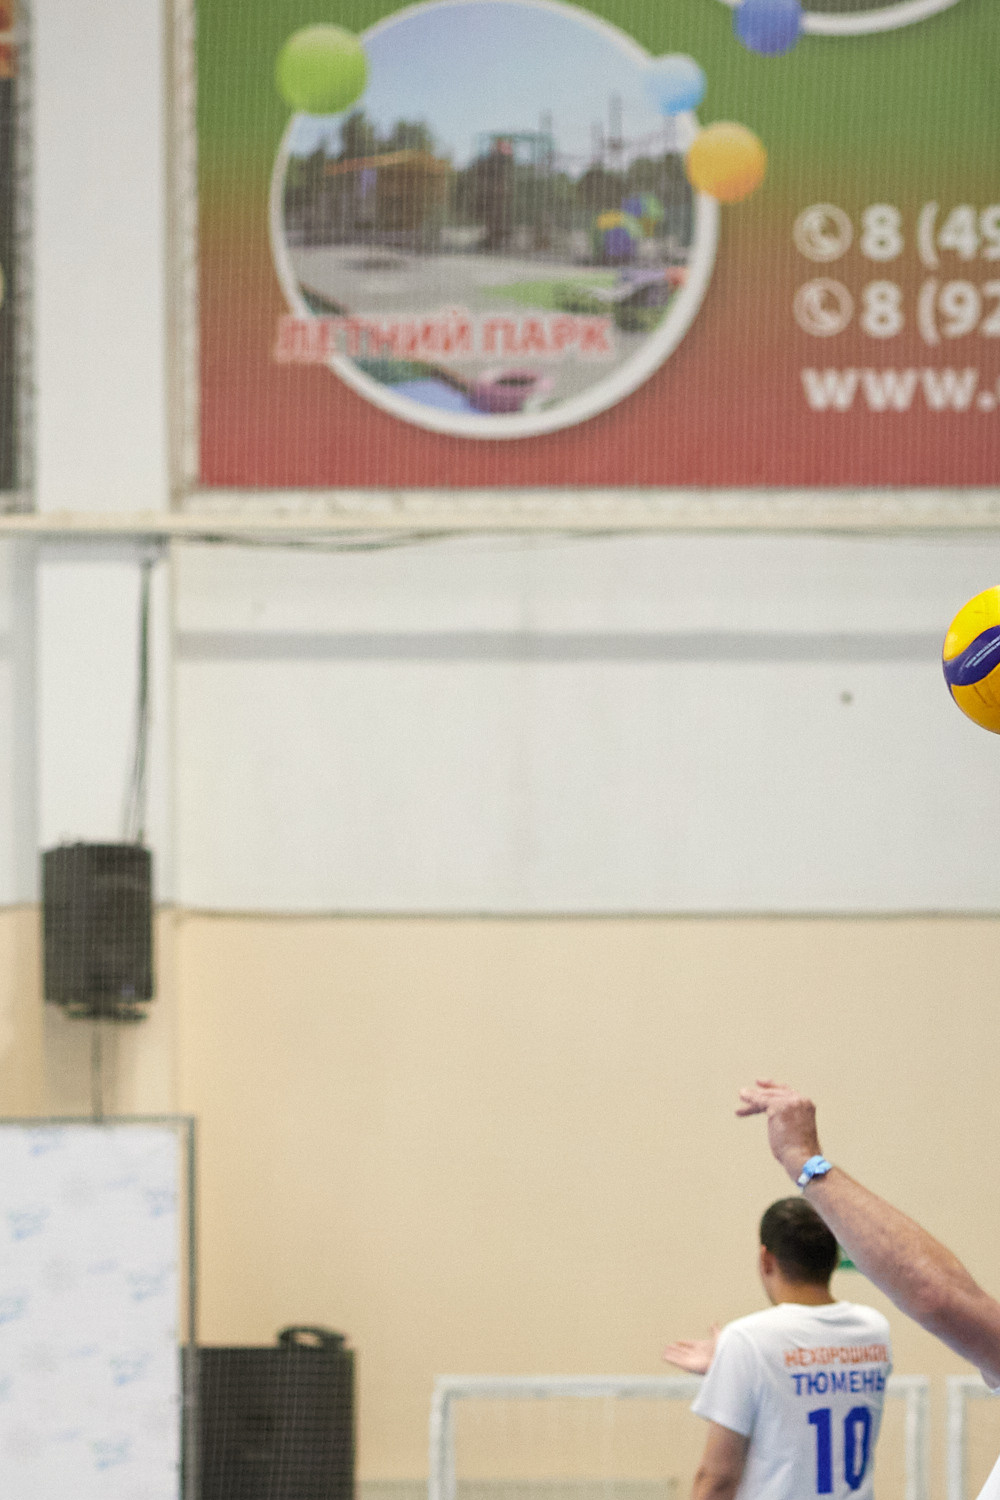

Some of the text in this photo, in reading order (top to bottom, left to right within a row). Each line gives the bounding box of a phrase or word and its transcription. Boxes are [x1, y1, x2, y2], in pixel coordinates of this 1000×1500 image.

[861, 203, 904, 263] 8
[280, 306, 612, 358] ЛЕТНИЙ ПАРК
[861, 280, 904, 339] 8
[790, 1367, 886, 1396] ТЮМЕНЬ
[807, 1405, 872, 1494] 10
